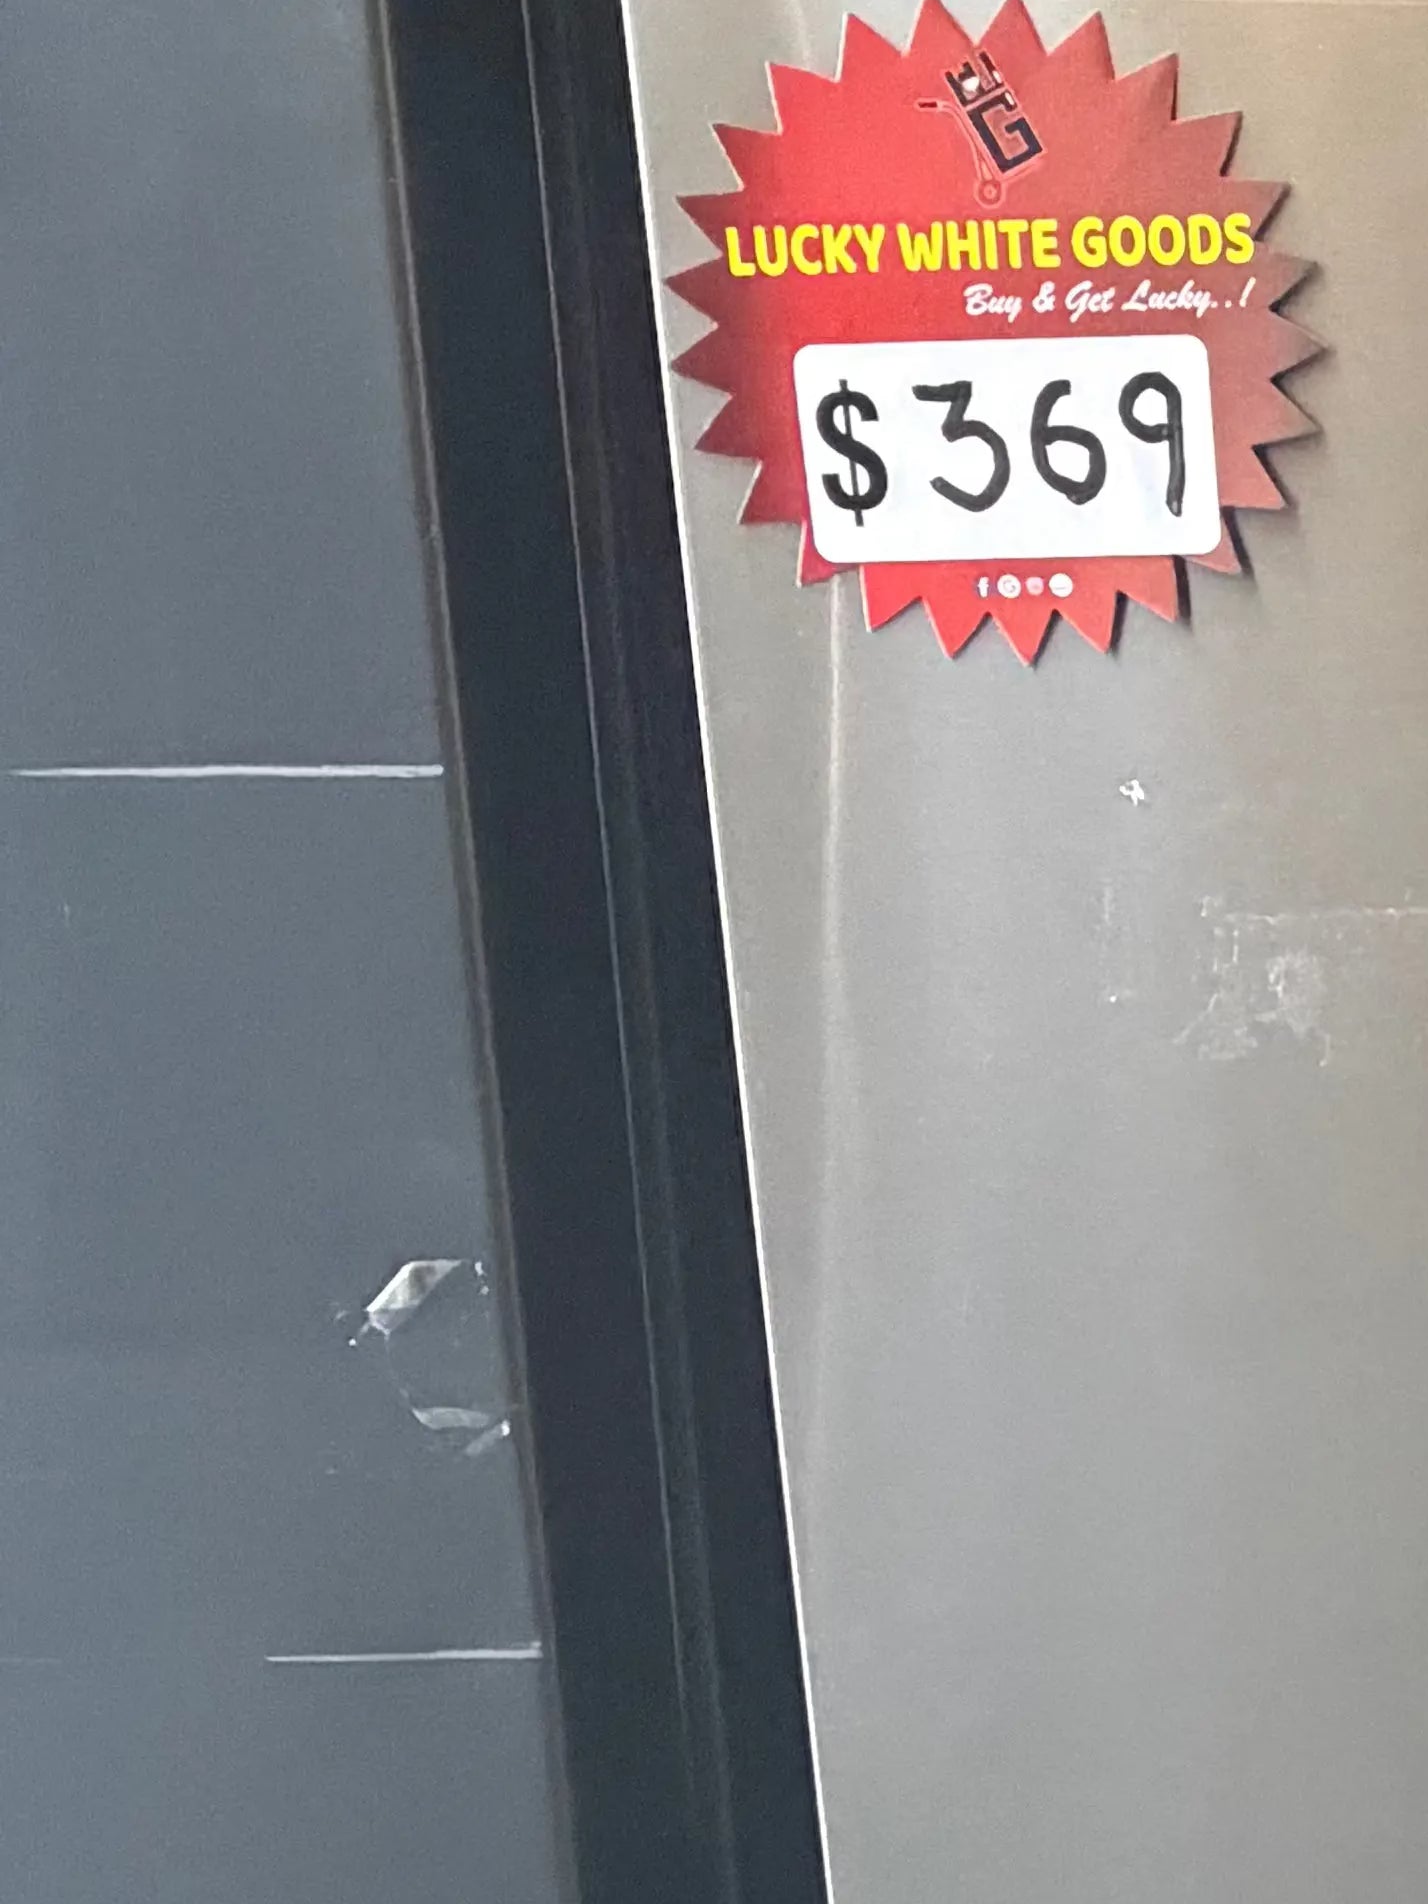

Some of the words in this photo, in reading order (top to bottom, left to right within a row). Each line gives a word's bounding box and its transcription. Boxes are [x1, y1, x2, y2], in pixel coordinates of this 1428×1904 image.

[725, 224, 886, 278] LUCKY
[898, 218, 1063, 272] WHITE
[1071, 213, 1254, 268] GOODS
[964, 286, 1023, 319] Buy
[1031, 286, 1057, 314] &
[1066, 282, 1113, 323] Get
